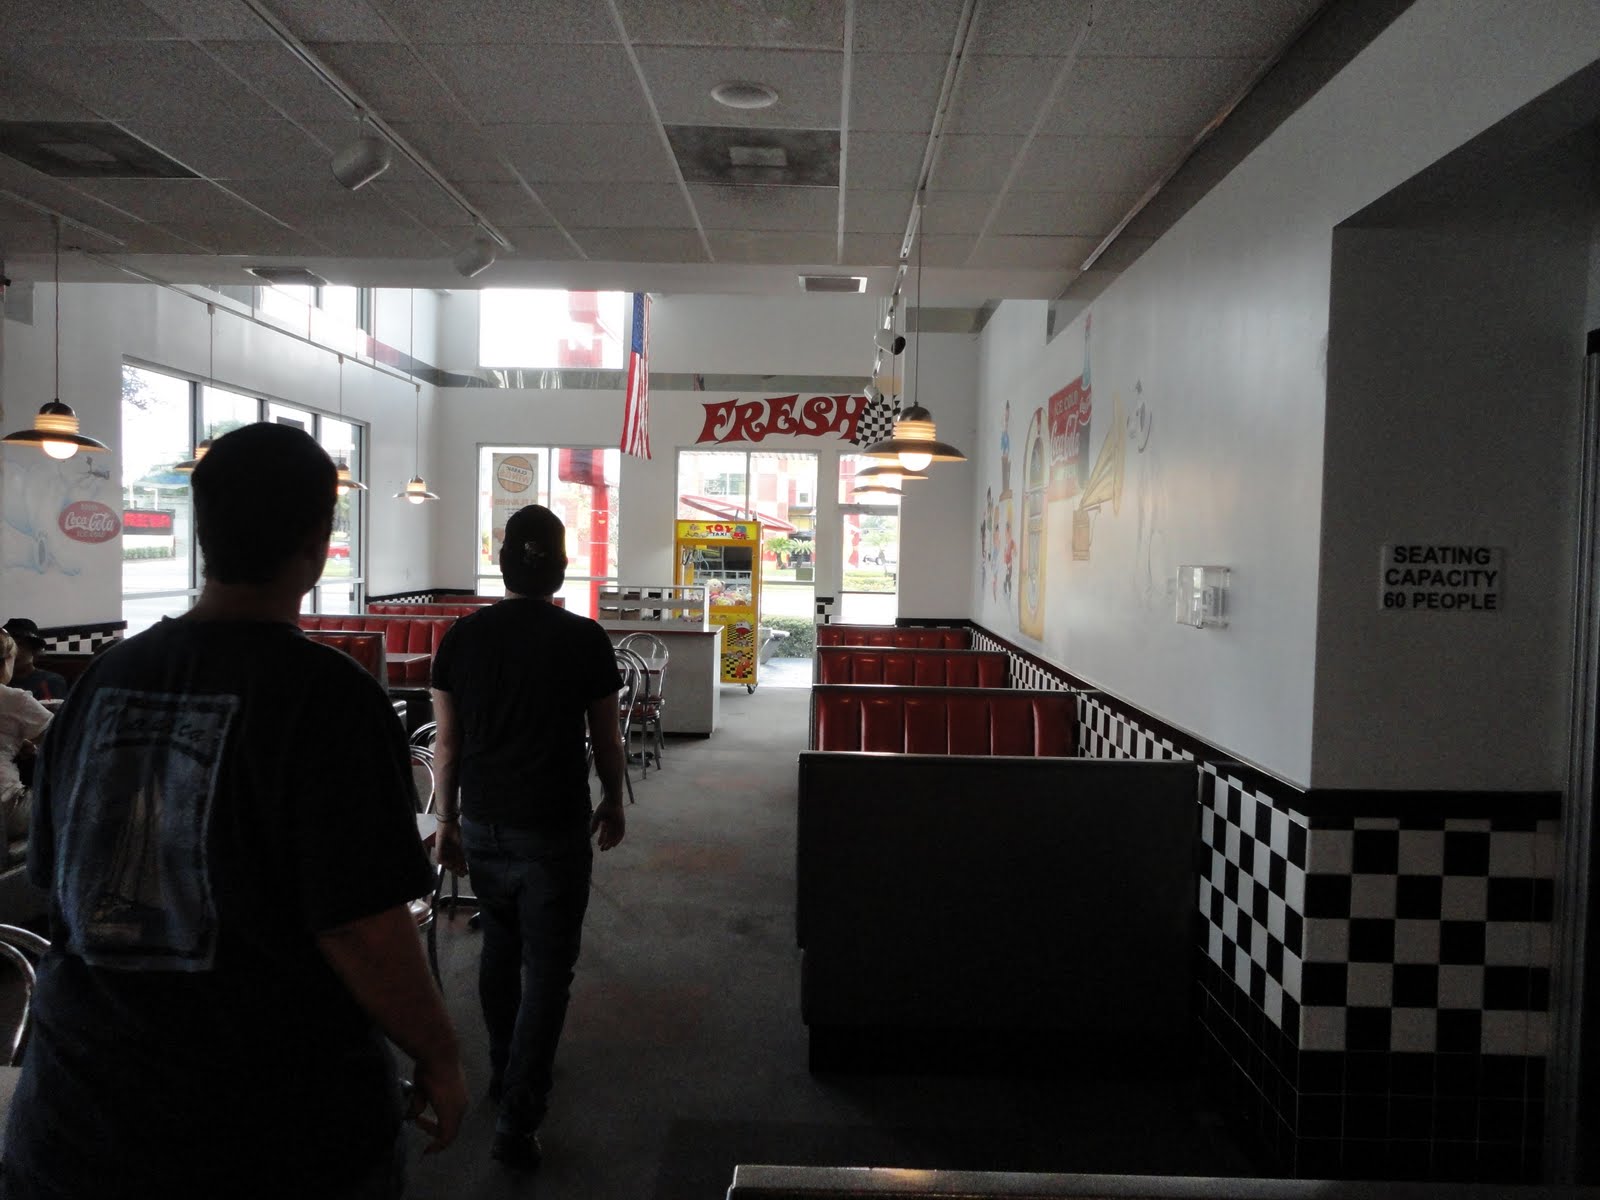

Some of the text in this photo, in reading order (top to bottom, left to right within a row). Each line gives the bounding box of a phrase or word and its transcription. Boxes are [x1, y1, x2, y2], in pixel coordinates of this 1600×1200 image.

[695, 394, 868, 444] FRESH
[706, 523, 734, 534] TOY
[1393, 546, 1491, 565] SEATING
[1385, 568, 1497, 587] CAPACITY
[1383, 592, 1497, 610] 60 PEOPLE
